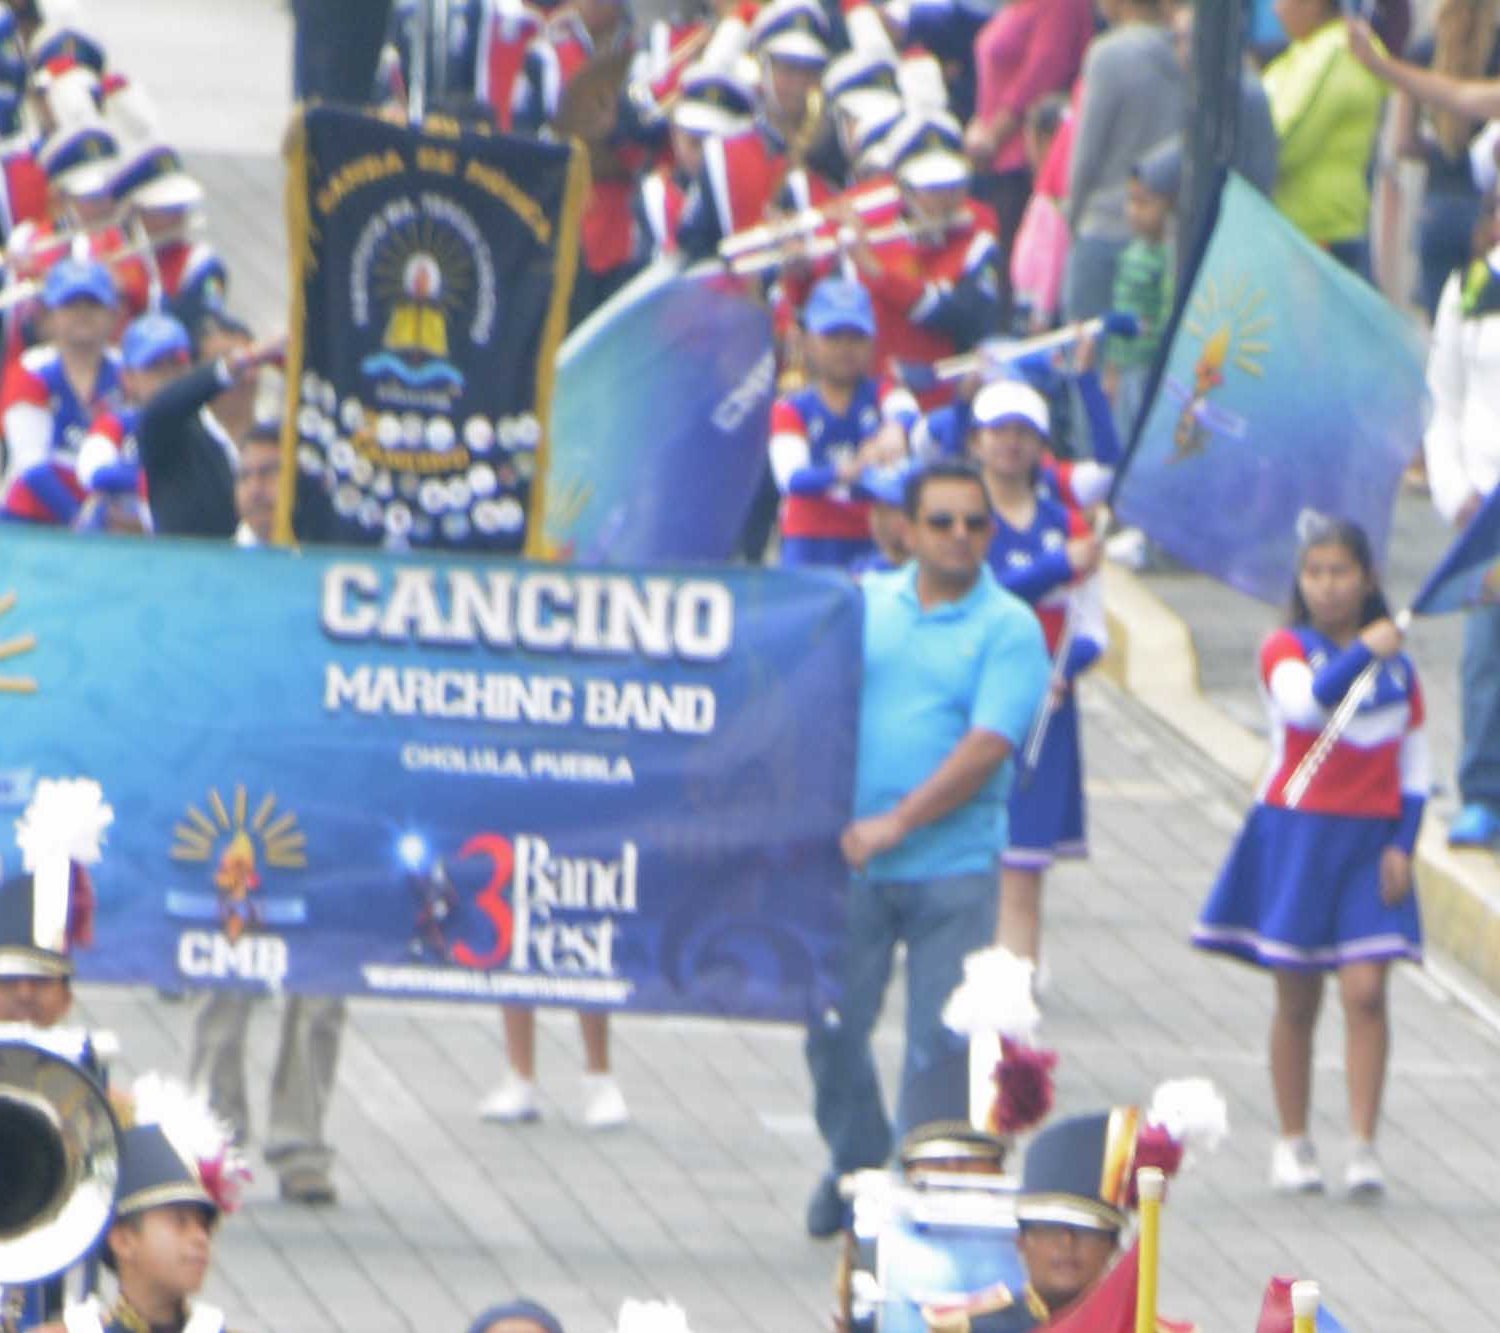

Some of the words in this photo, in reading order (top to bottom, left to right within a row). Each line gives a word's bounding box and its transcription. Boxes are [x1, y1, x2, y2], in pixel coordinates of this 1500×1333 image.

[320, 562, 734, 661] CANCINO
[325, 663, 574, 725] MARCHING
[584, 679, 717, 735] BAND
[532, 749, 636, 785] PUEBLA
[451, 830, 515, 970] 3
[511, 832, 638, 914] Band
